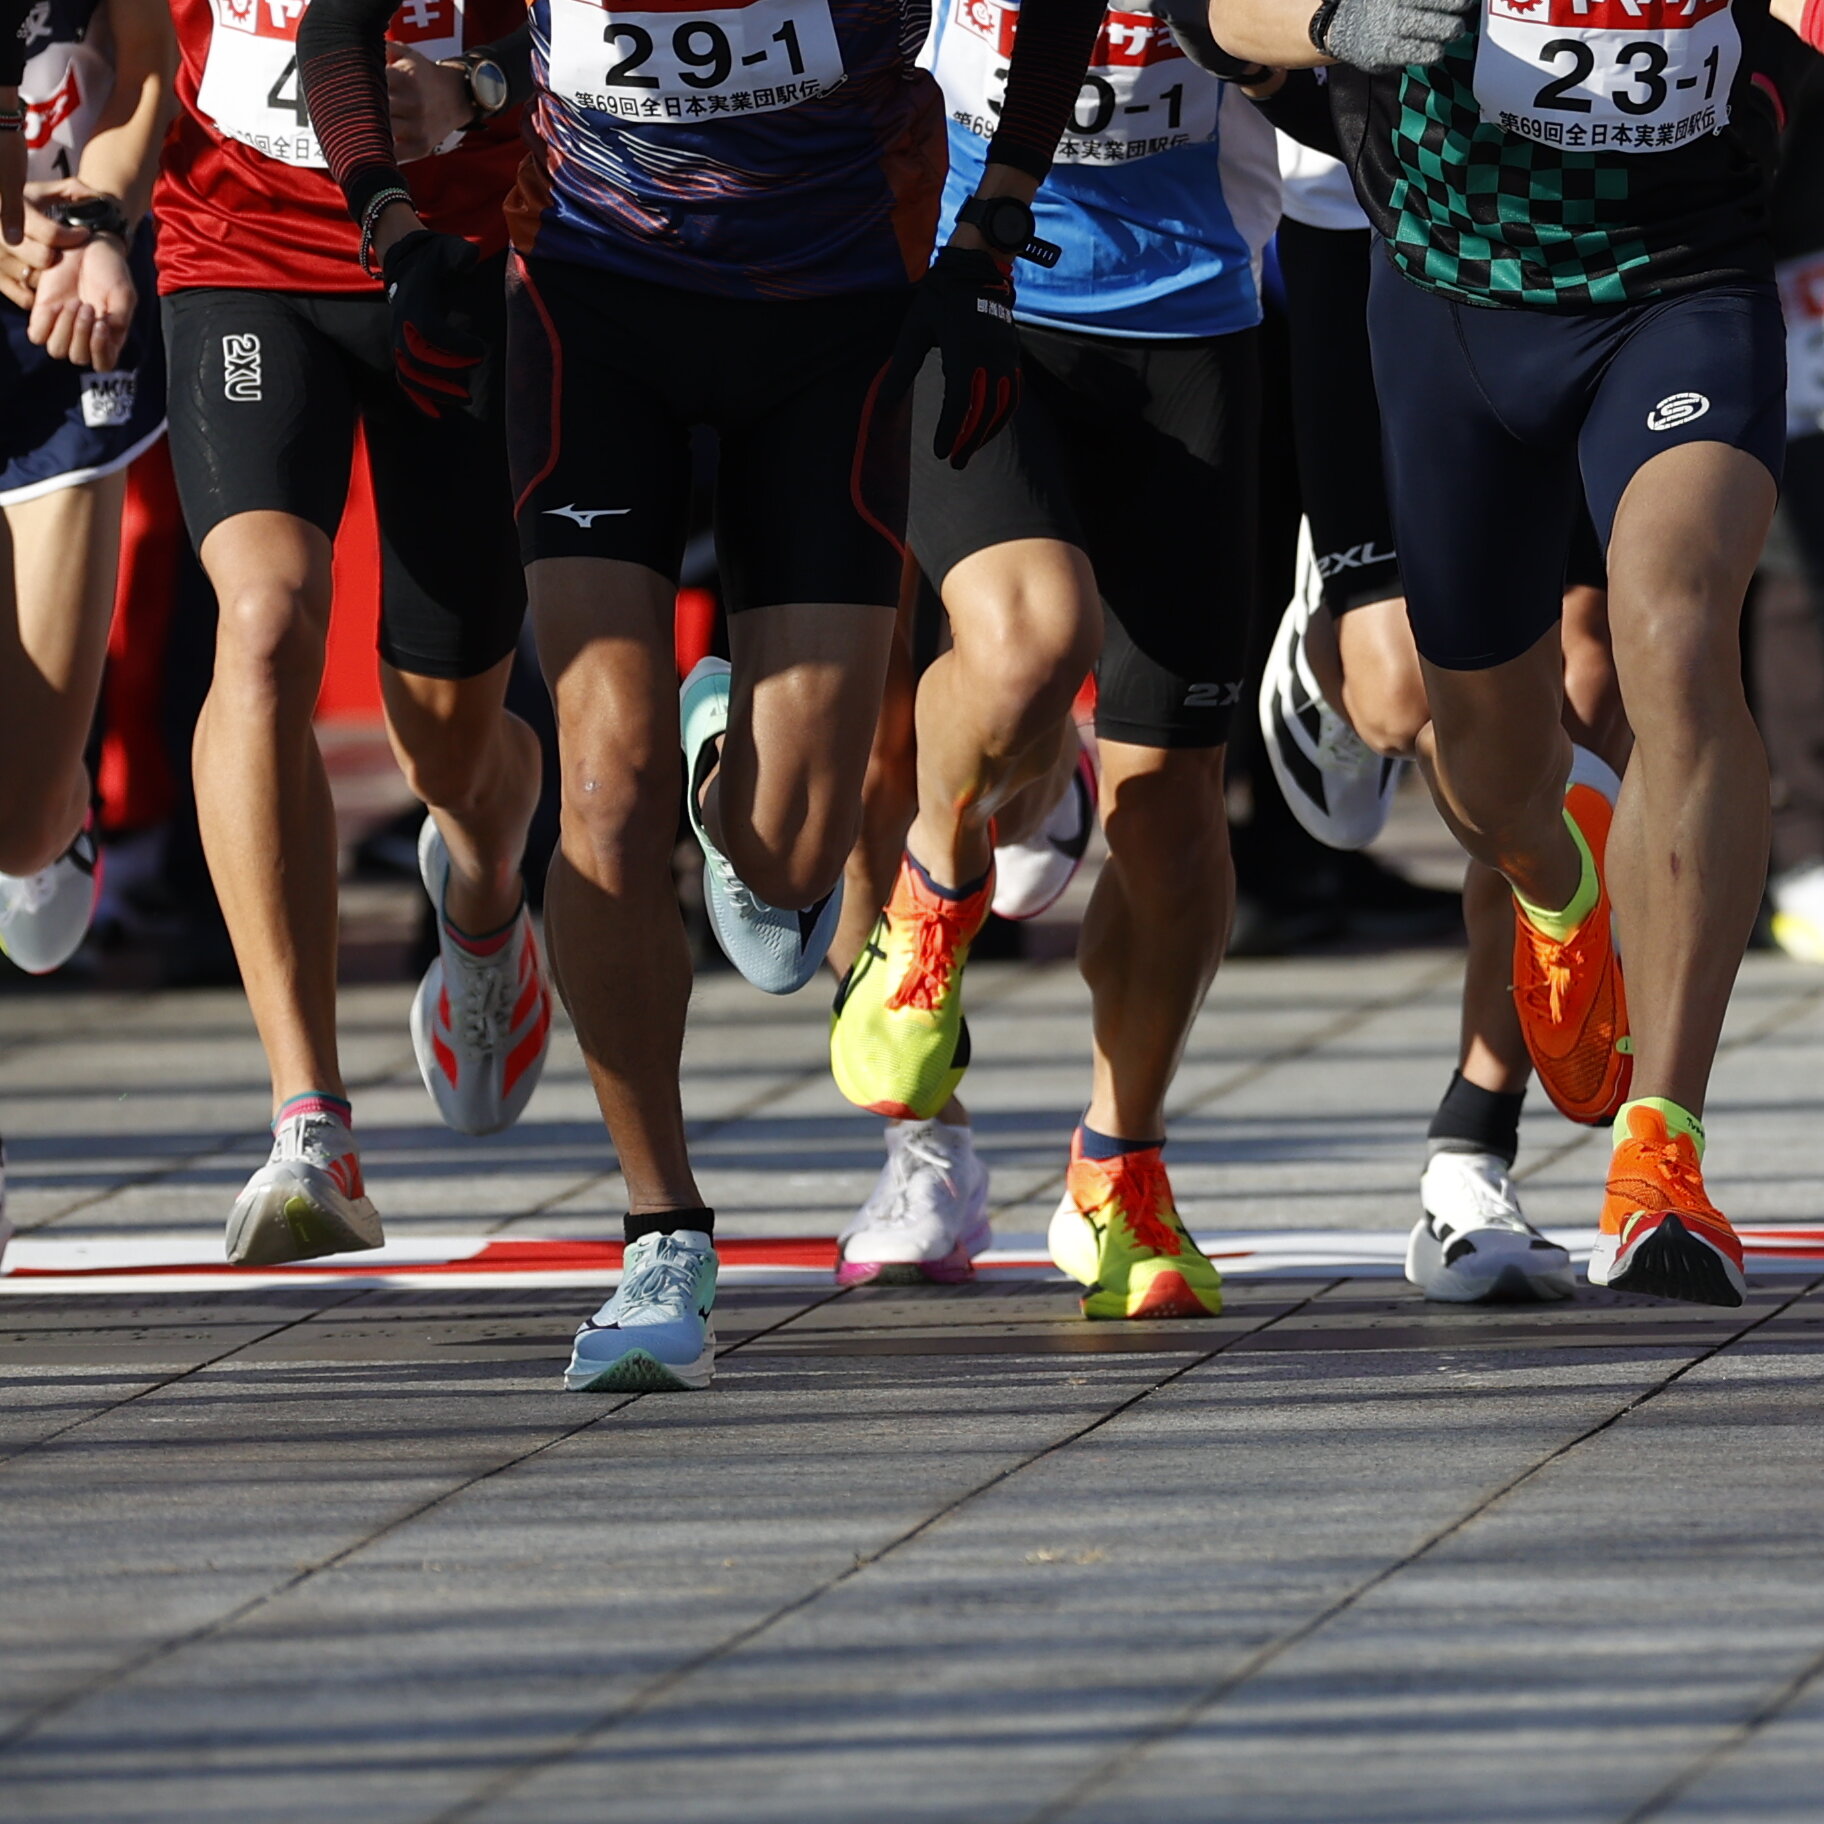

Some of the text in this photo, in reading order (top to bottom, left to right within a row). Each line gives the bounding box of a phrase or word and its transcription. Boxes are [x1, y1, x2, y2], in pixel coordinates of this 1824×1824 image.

[601, 19, 807, 90] 29-1
[1532, 38, 1720, 117] 23-1
[222, 333, 261, 402] 2XU
